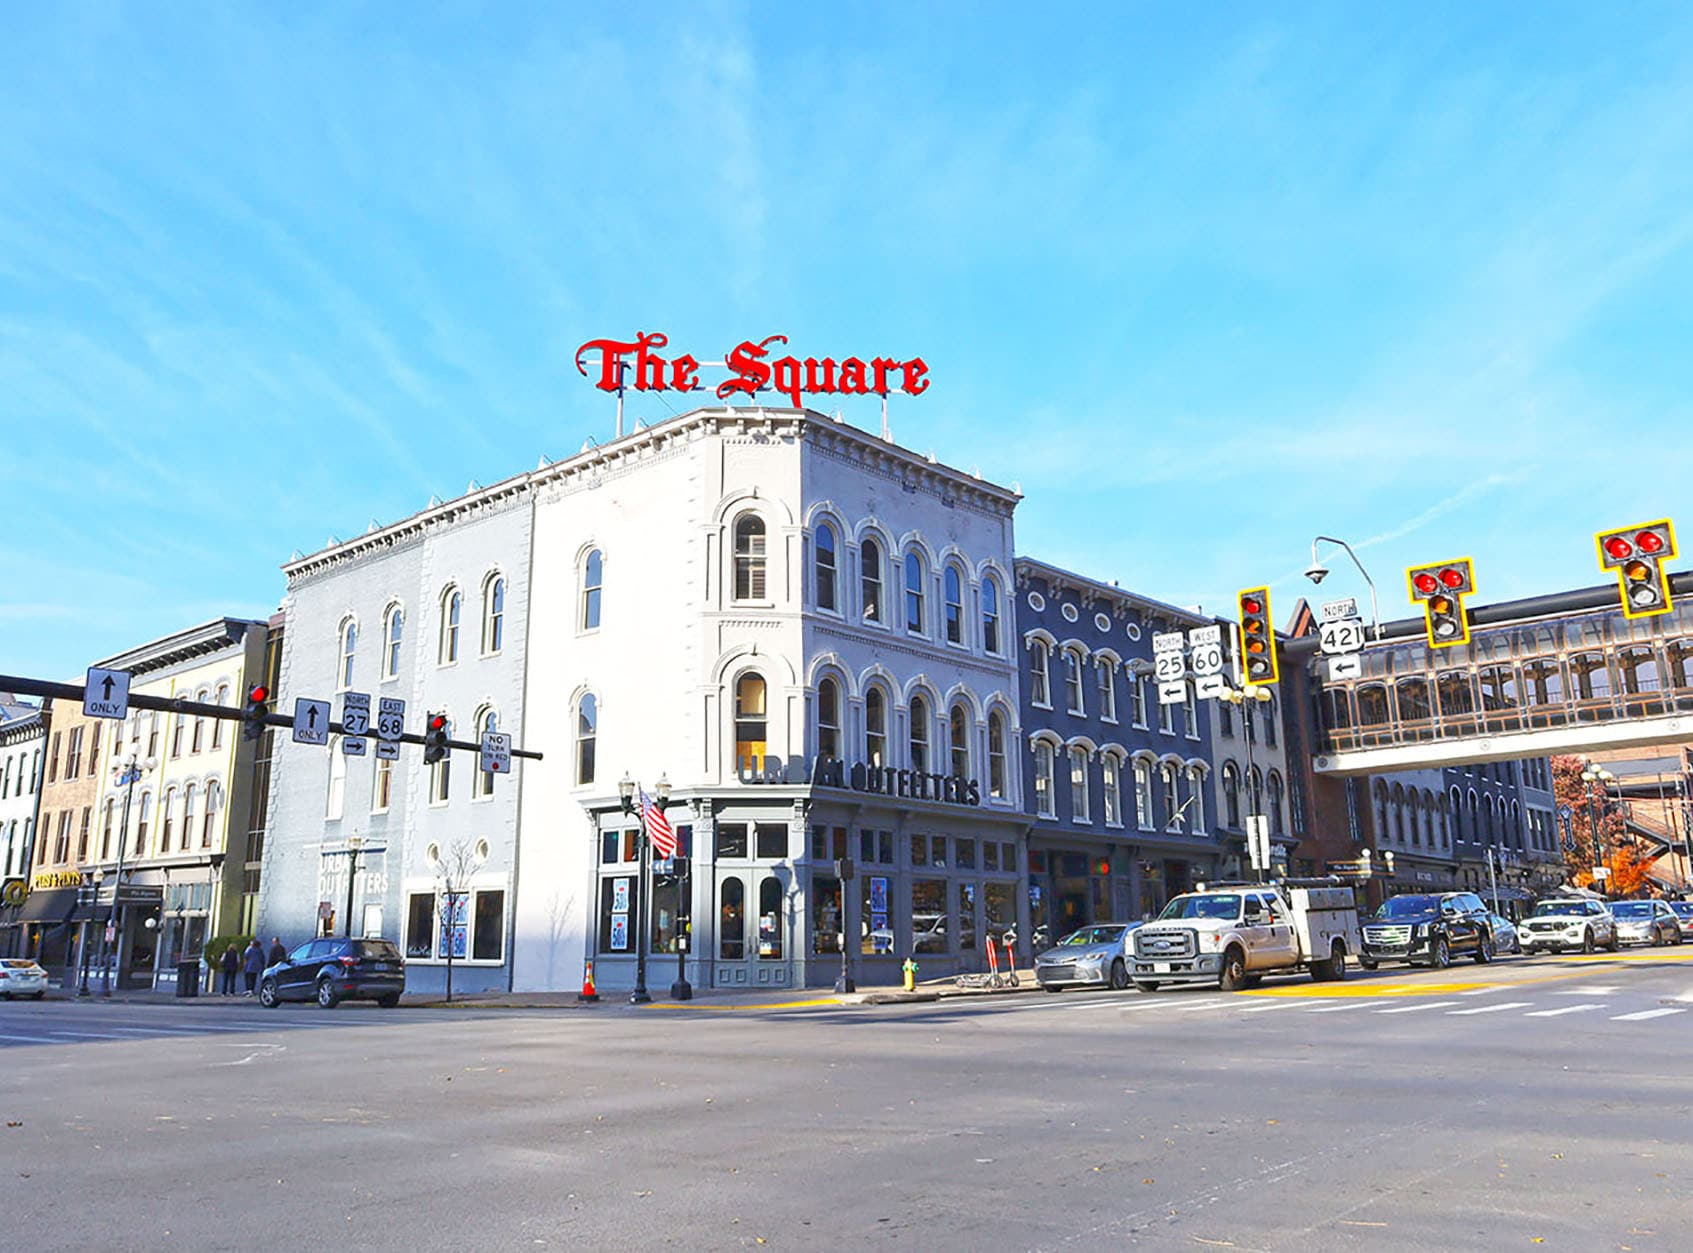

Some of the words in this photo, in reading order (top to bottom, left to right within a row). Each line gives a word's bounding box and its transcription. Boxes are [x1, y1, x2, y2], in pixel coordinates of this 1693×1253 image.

[575, 331, 699, 394] The
[716, 335, 930, 408] Square
[1324, 604, 1354, 617] NORTH
[1194, 630, 1216, 641] WEST
[1323, 626, 1360, 647] 421
[1156, 637, 1180, 649] NORTH
[1159, 656, 1182, 676] 25
[1195, 650, 1219, 670] 60
[90, 702, 120, 714] ONLY
[383, 701, 401, 711] EAST
[345, 715, 367, 731] 27
[380, 718, 401, 735] 68
[299, 729, 322, 740] ONLY
[489, 735, 504, 744] NO
[738, 754, 845, 786] URBAN
[850, 761, 981, 806] OUTFITTERS
